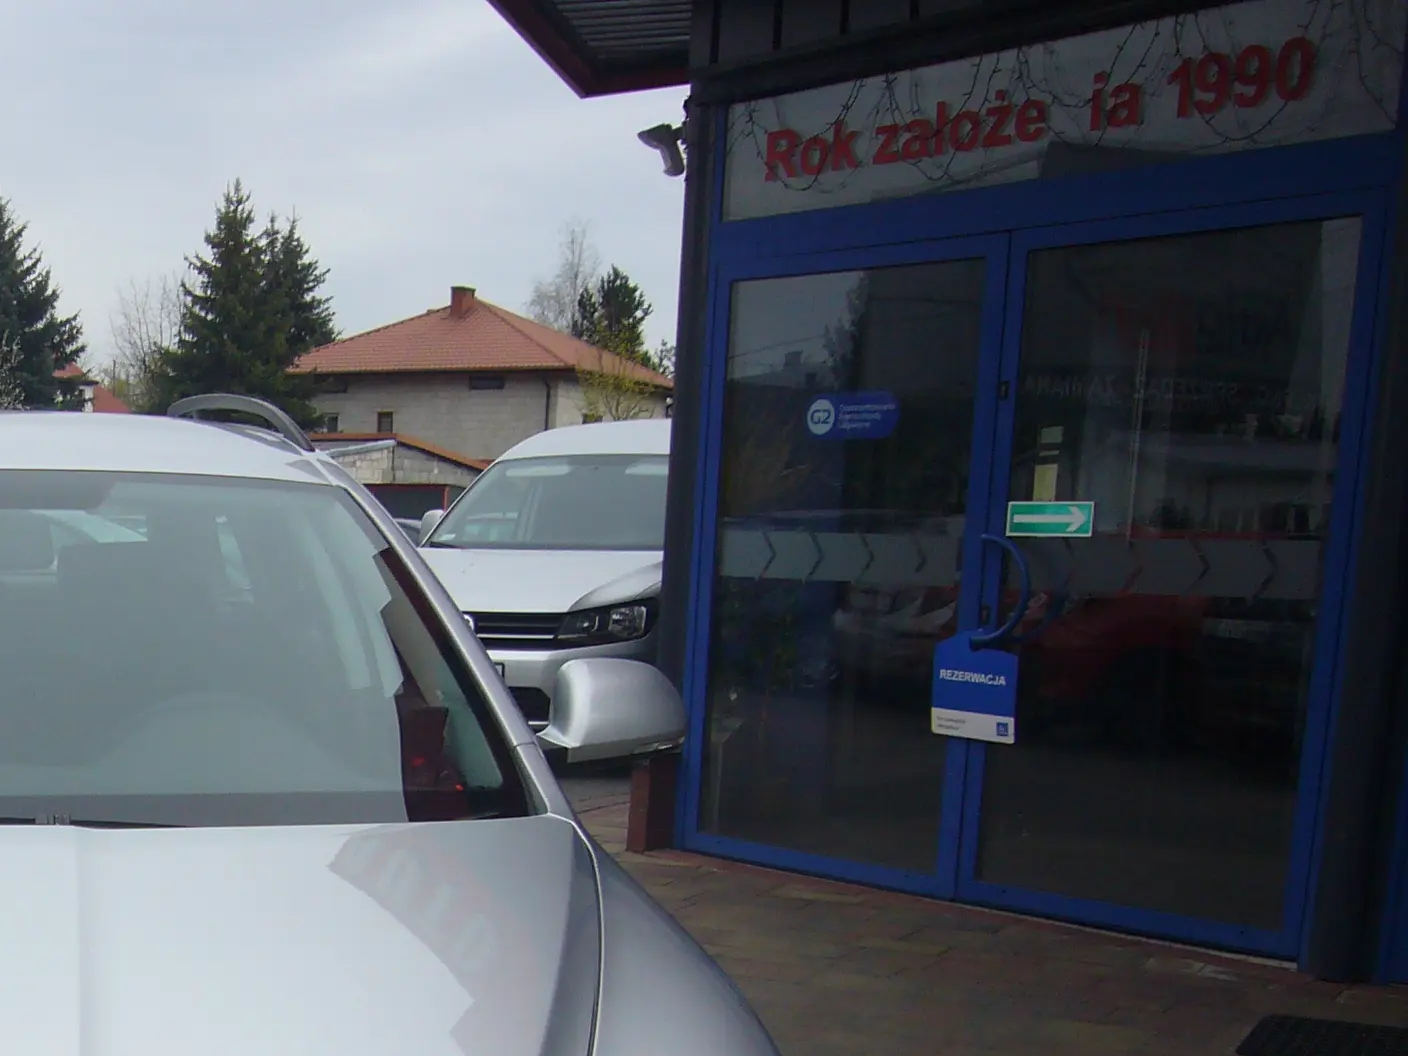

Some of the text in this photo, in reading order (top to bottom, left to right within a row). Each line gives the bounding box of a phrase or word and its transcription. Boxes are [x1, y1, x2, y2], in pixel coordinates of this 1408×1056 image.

[765, 119, 866, 182] Rok
[1166, 35, 1316, 119] 1990
[810, 409, 832, 425] G2
[939, 669, 1006, 685] REZERWACJA
